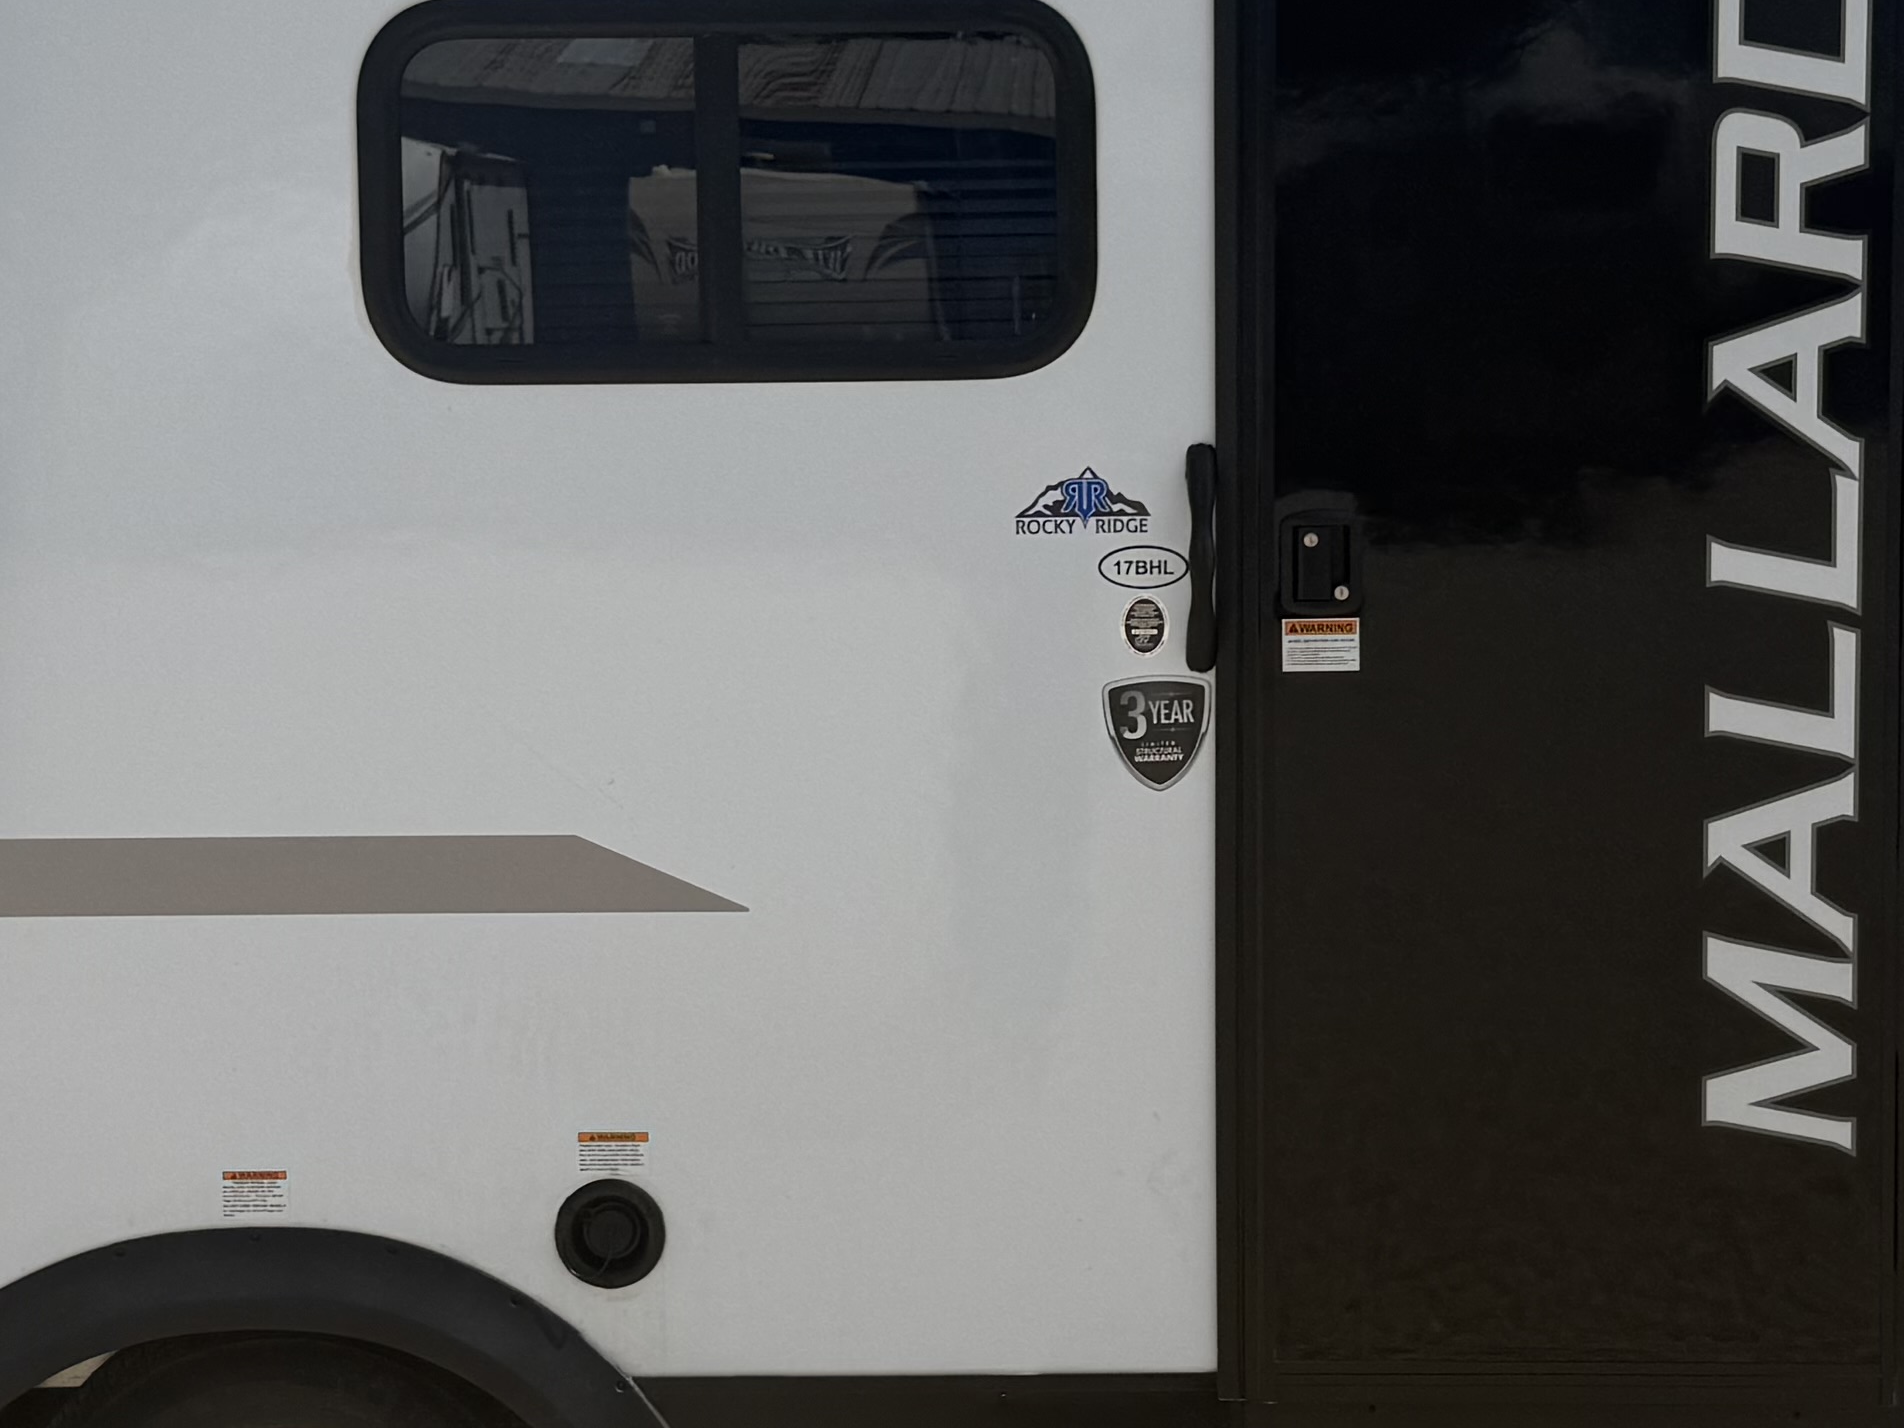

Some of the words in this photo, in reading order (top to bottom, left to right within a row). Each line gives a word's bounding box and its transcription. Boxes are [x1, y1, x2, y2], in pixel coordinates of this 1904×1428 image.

[1015, 518, 1076, 535] ROCKY
[1095, 517, 1149, 534] RIDGE
[1113, 559, 1175, 575] 17BHL
[1299, 622, 1353, 633] WARNING
[1119, 689, 1148, 740] 3
[1148, 699, 1195, 725] YEAR
